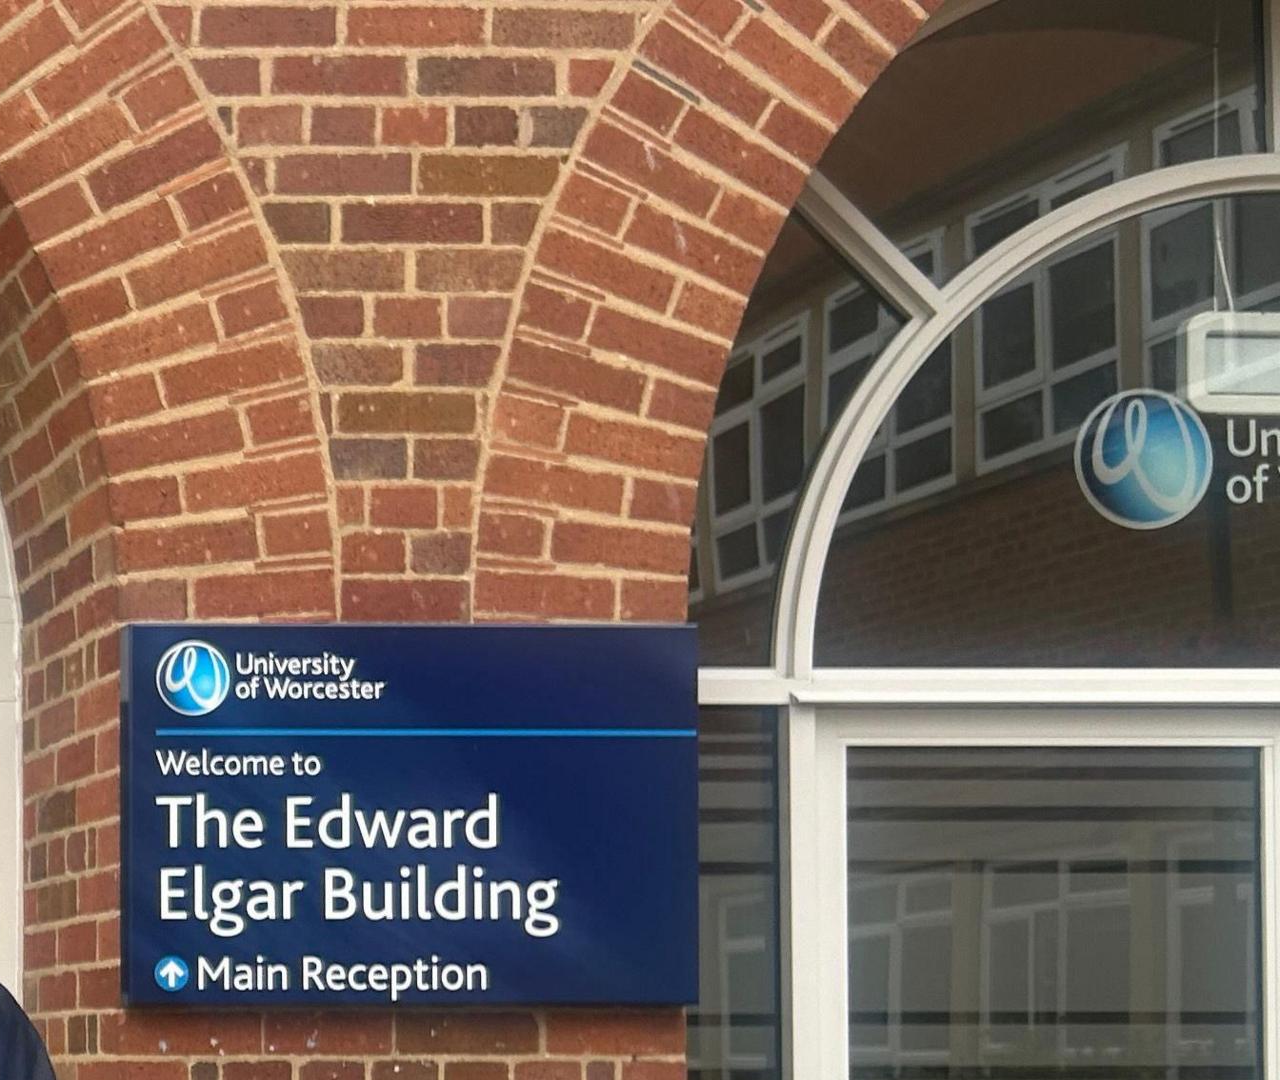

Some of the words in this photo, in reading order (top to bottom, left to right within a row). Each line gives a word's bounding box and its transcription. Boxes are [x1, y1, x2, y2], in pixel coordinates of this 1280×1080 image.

[1226, 463, 1270, 504] of
[237, 652, 355, 680] University
[236, 676, 260, 699] of
[264, 676, 384, 699] Worcester
[156, 749, 284, 775] Welcome
[292, 753, 321, 775] to
[156, 793, 263, 848] The
[287, 793, 497, 848] Edward
[161, 865, 304, 936] Elgar
[325, 865, 558, 936] Building
[198, 956, 287, 990] Main
[303, 955, 487, 1001] Reception
